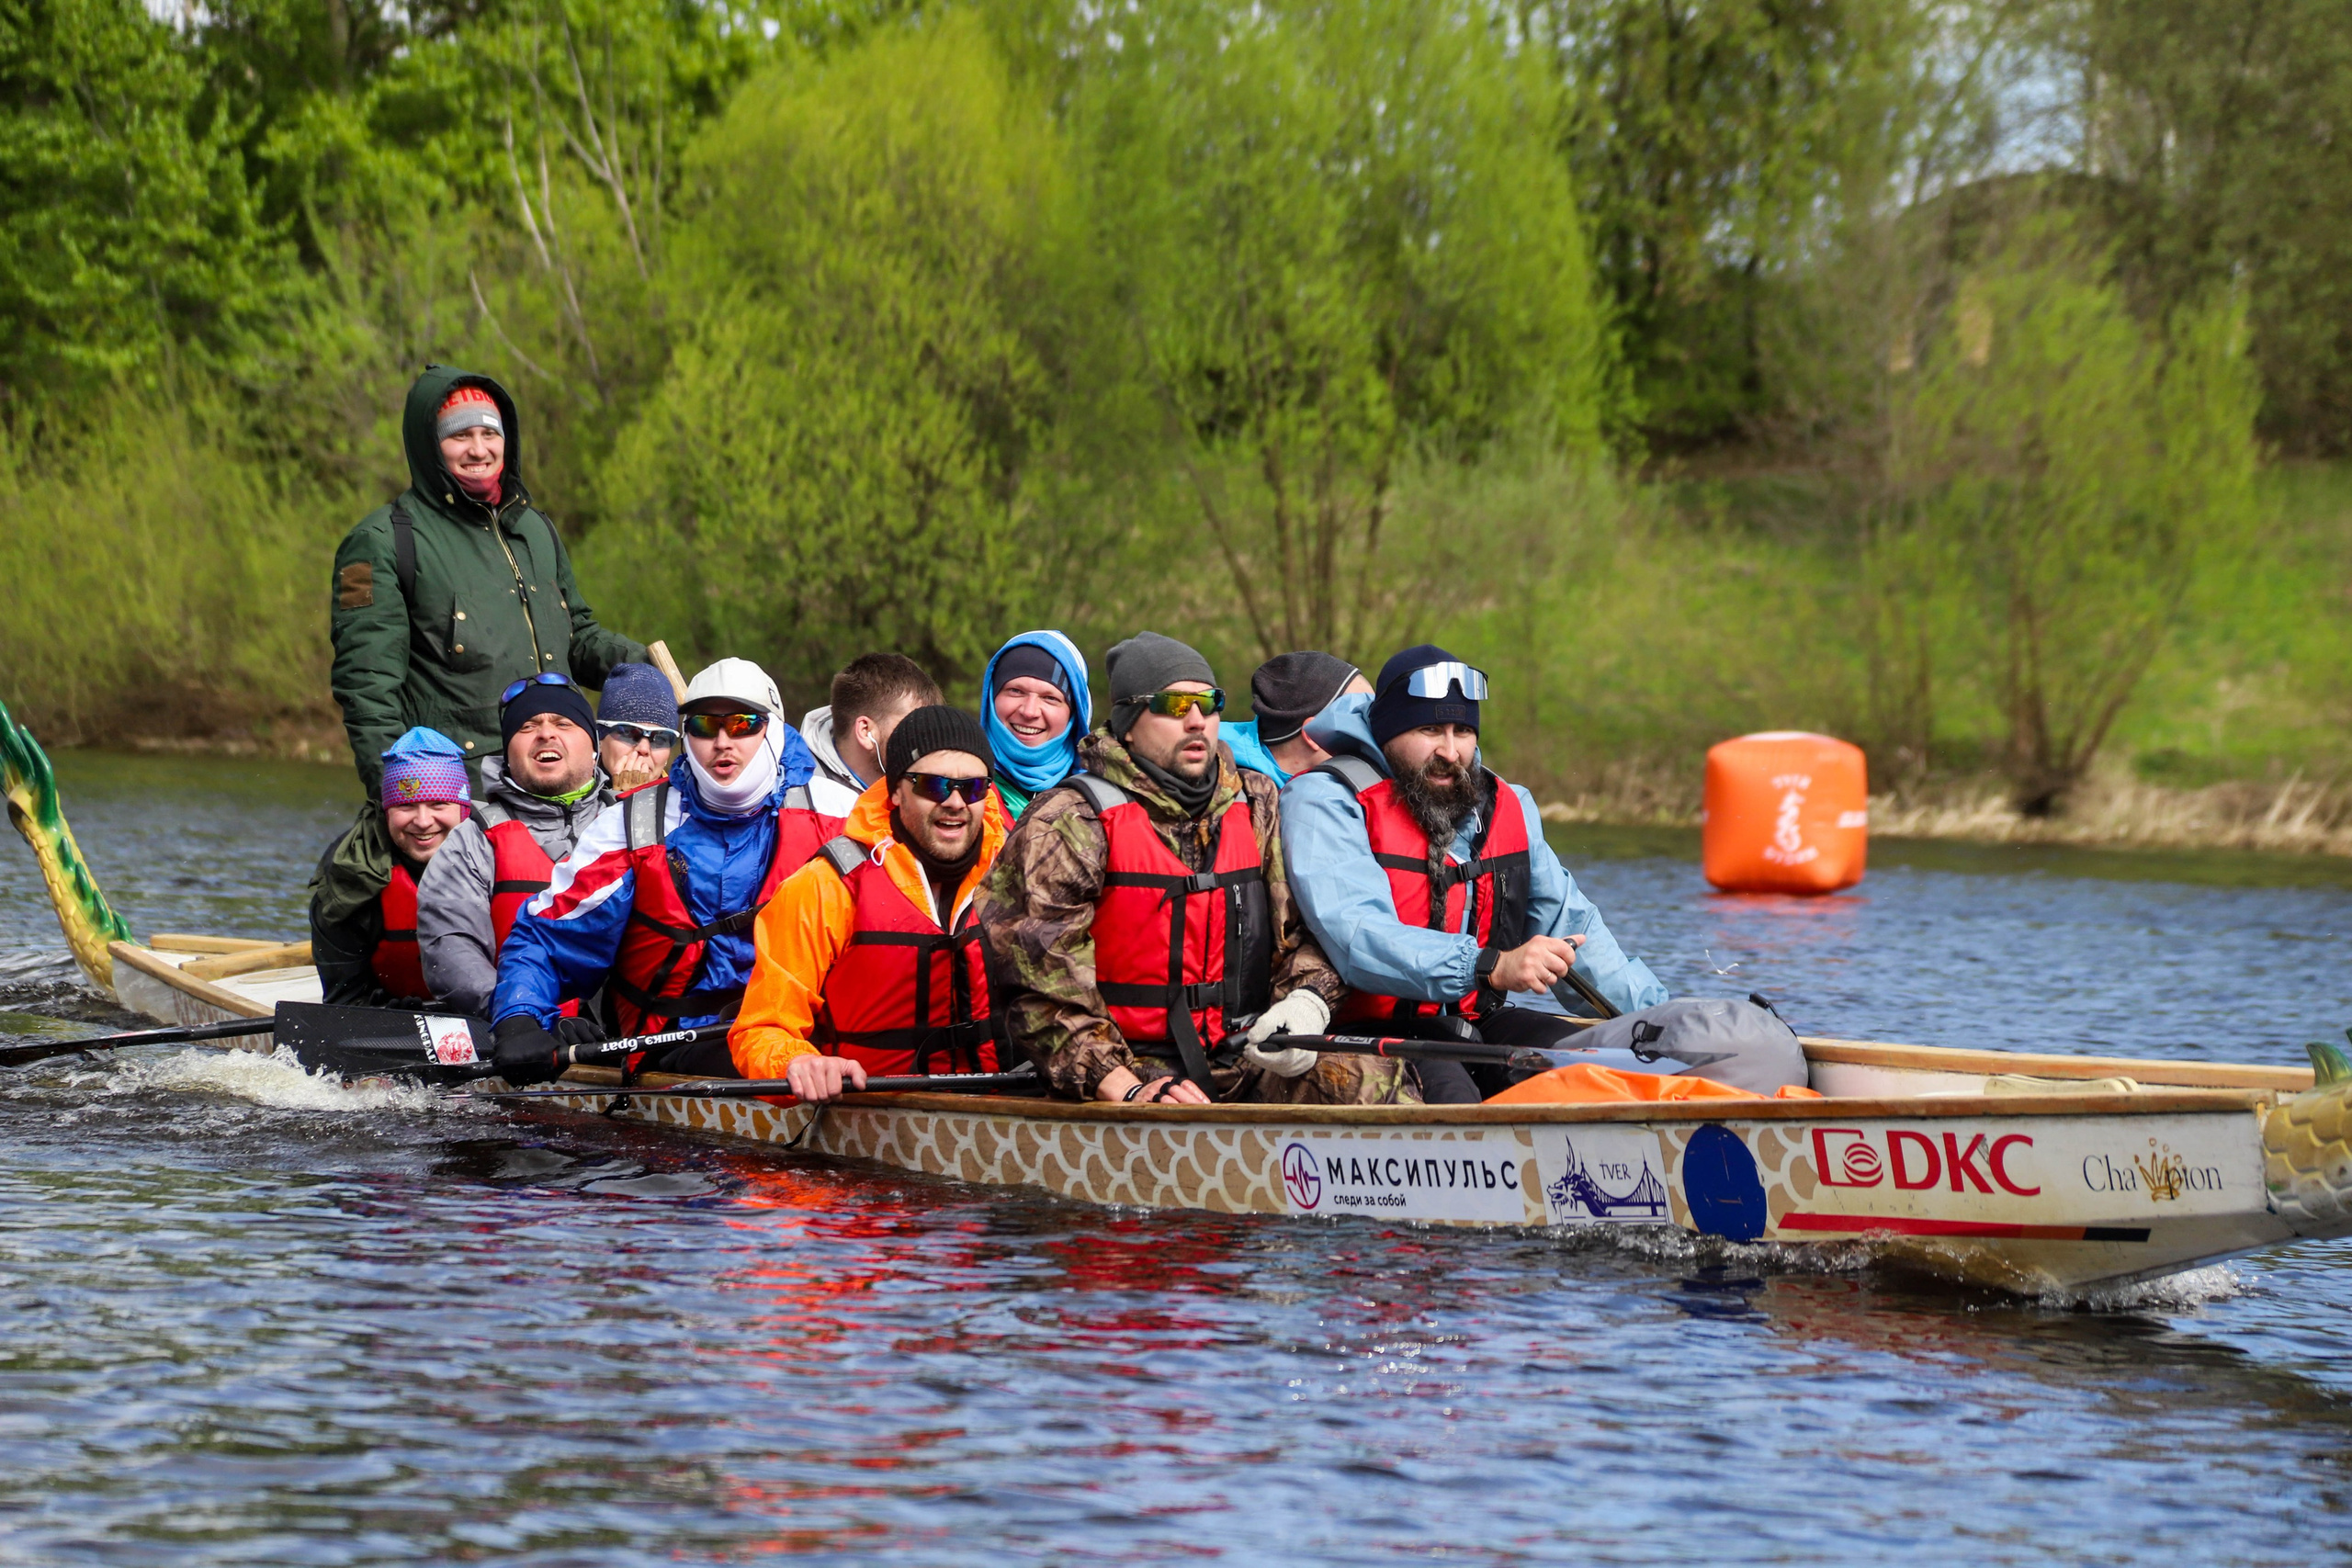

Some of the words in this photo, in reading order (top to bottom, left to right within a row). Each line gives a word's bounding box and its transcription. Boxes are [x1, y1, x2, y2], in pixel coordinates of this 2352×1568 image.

[1327, 1156, 1518, 1190] МАКСИПУЛЬС
[1599, 1162, 1632, 1180] TVER
[1885, 1130, 2041, 1197] DKC
[1333, 1194, 1363, 1207] следи
[1364, 1196, 1376, 1206] за
[1377, 1193, 1407, 1207] собой
